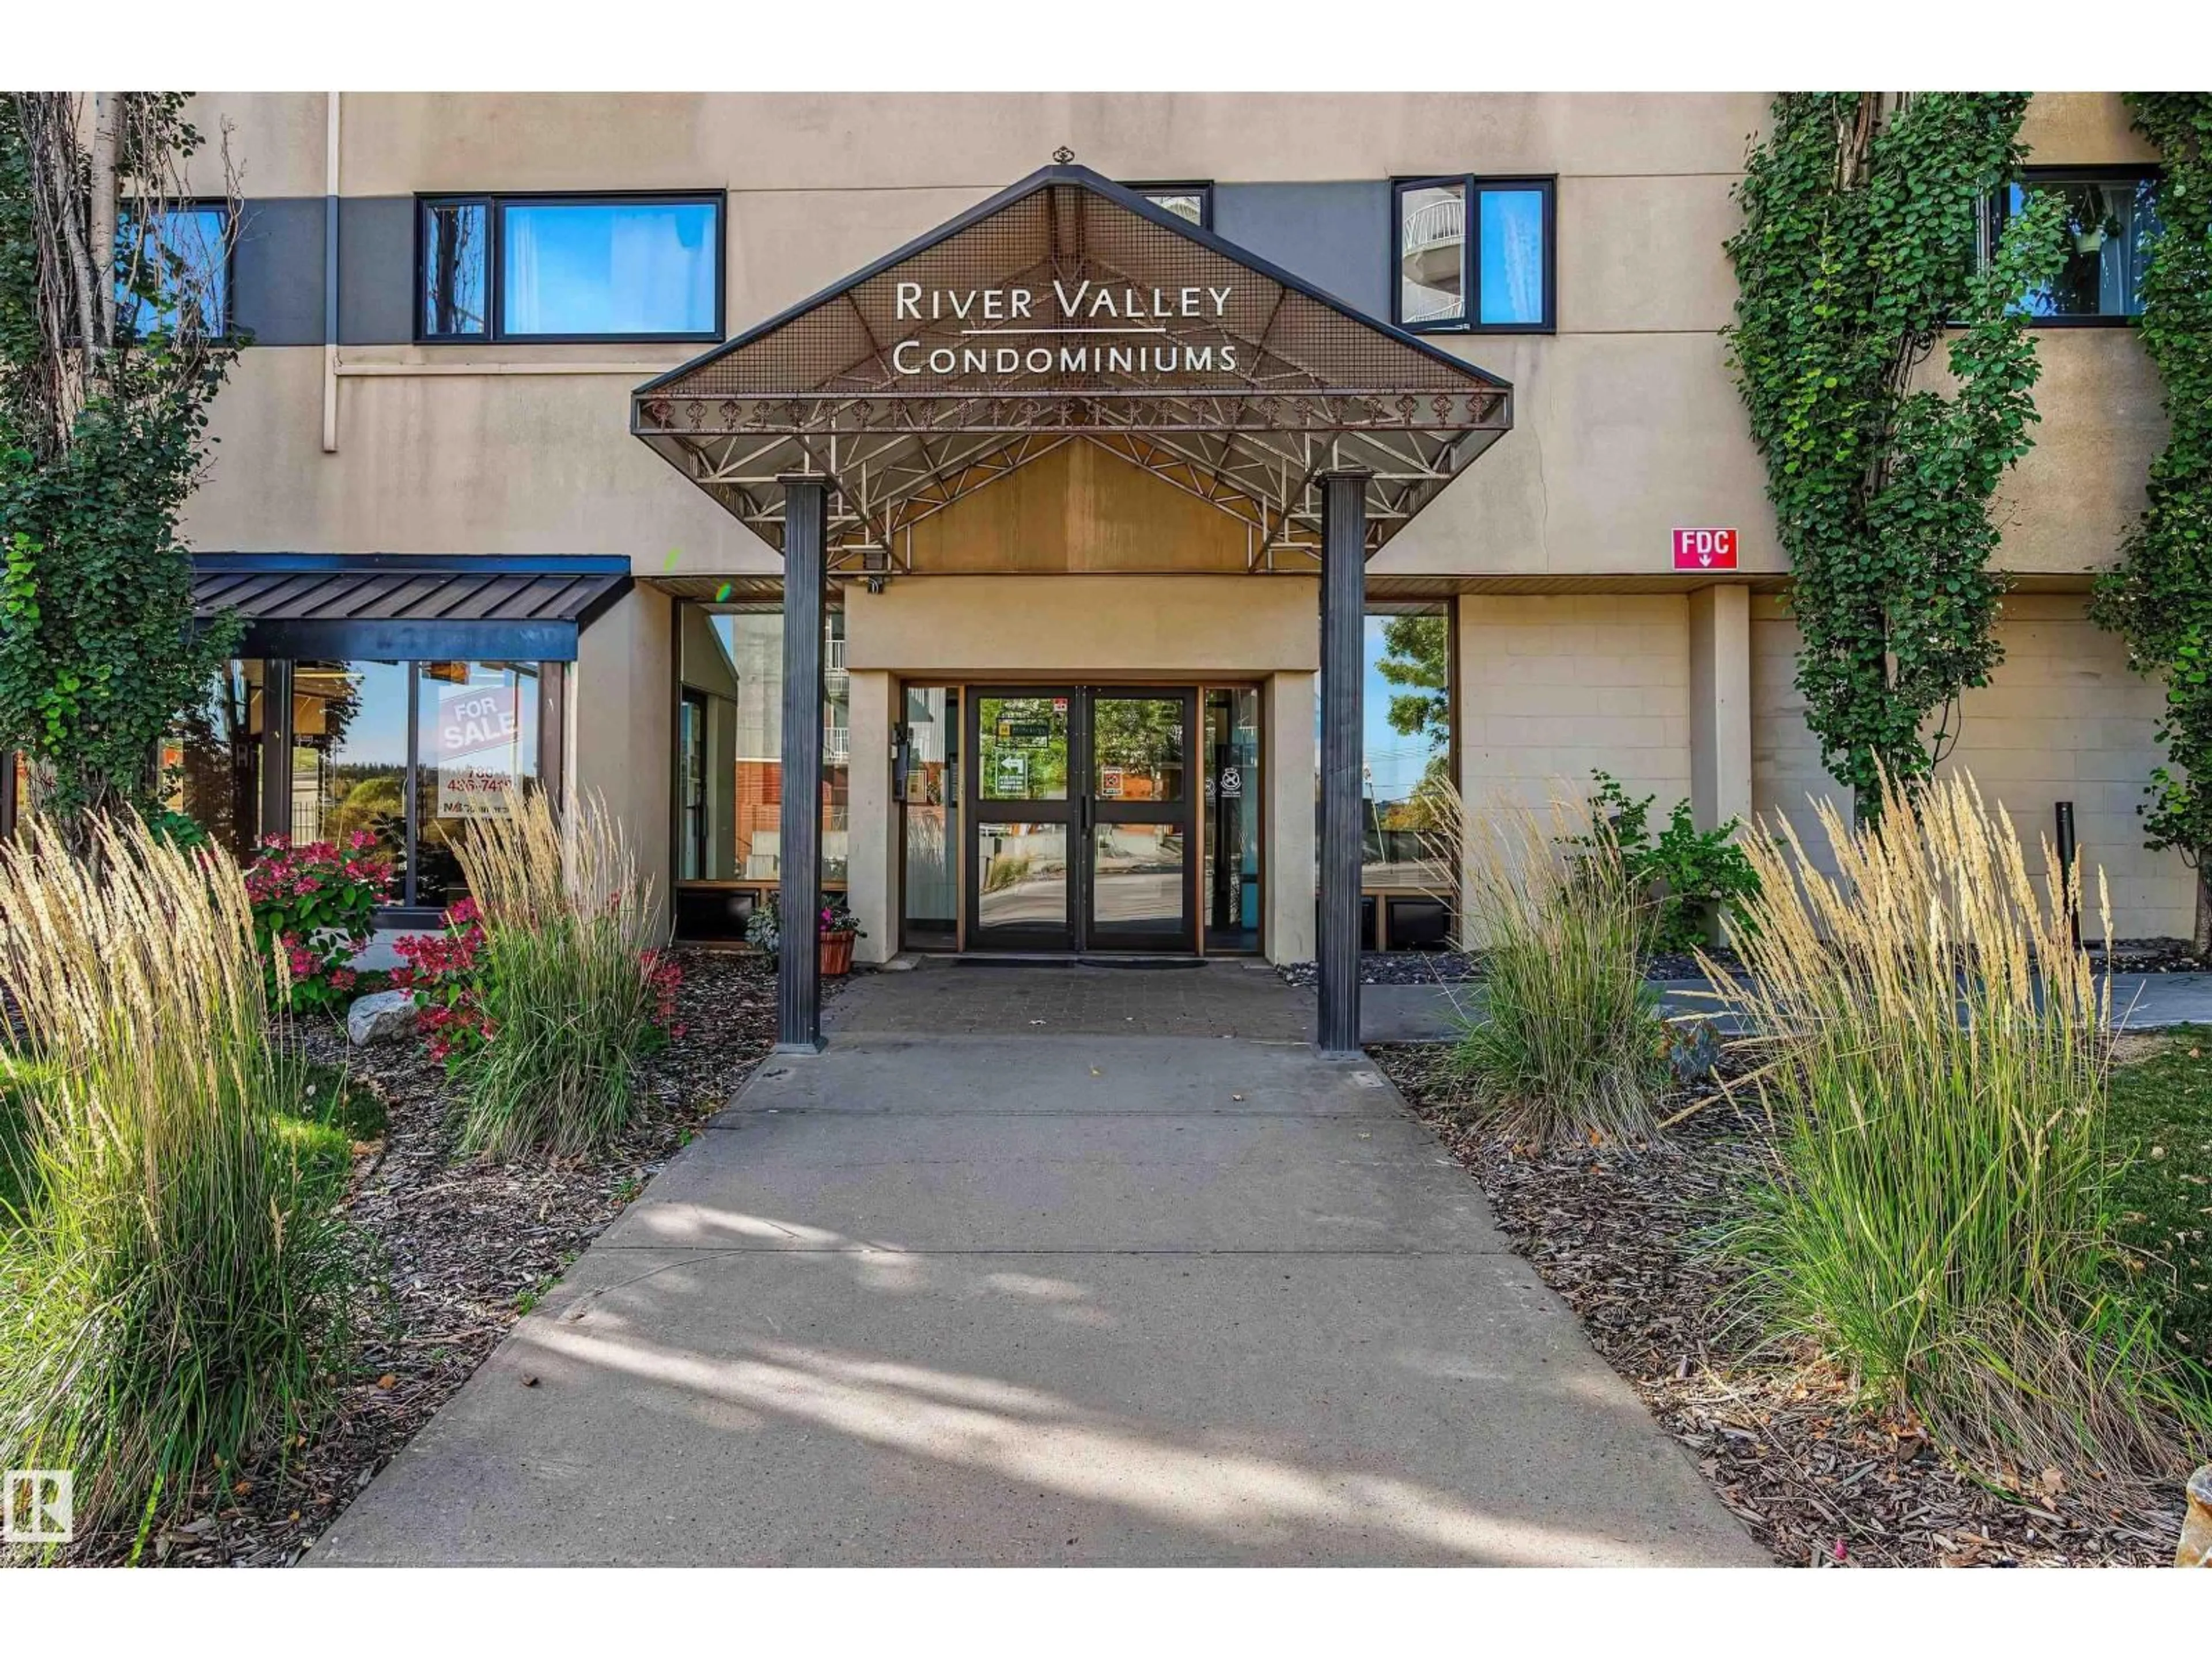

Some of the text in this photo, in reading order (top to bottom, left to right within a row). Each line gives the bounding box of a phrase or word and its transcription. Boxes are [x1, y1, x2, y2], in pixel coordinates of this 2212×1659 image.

[896, 280, 1232, 320] RIVER VALLEY
[893, 340, 1237, 374] CONDOMINIUMS
[1681, 531, 1729, 554] FDC
[454, 696, 498, 721] FOR
[444, 710, 516, 749] SALE
